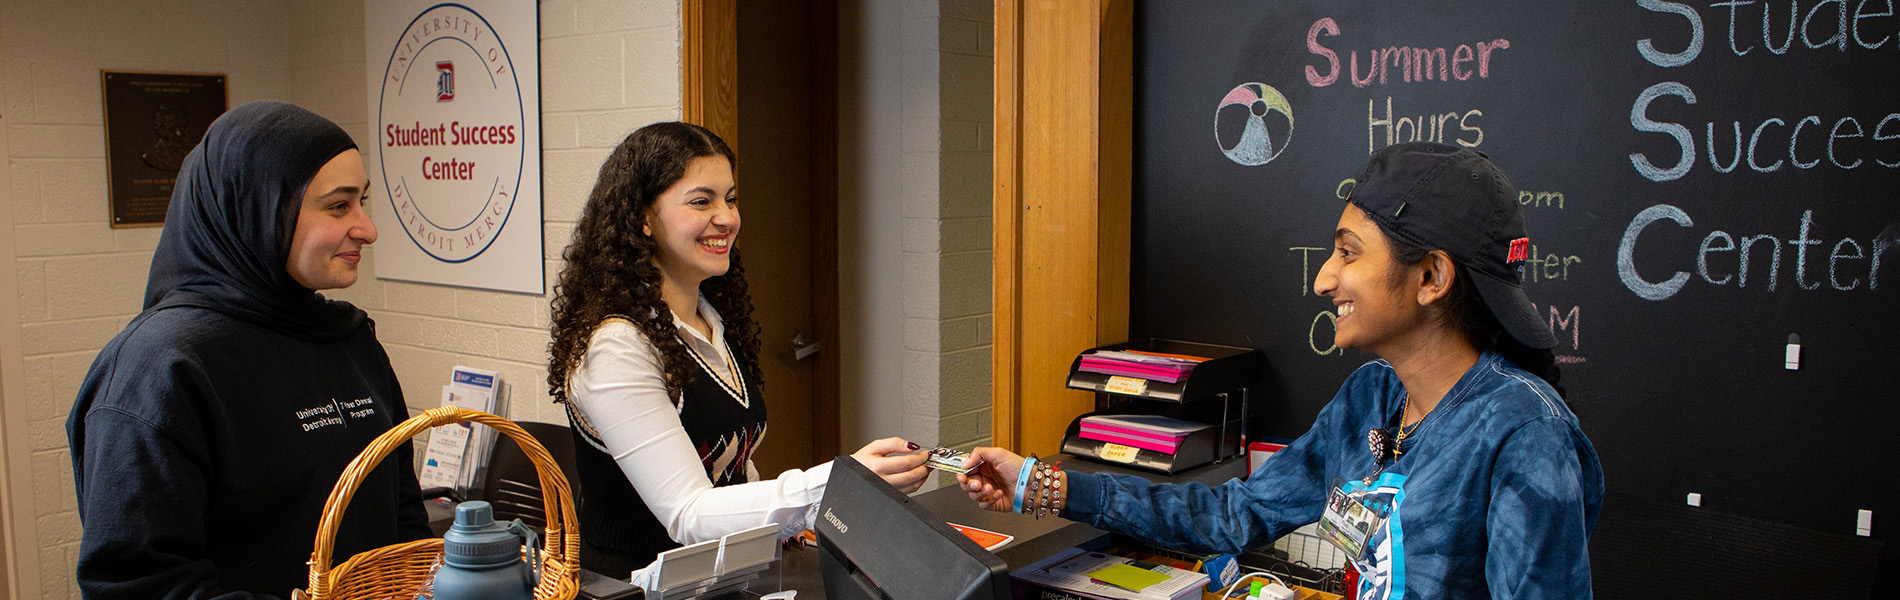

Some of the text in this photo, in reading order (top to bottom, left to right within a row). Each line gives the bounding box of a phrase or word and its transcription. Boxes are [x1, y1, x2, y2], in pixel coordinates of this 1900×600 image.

[392, 16, 506, 83] UNIVERSITY OF
[1305, 17, 1510, 88] Summer
[387, 121, 516, 147] Student Success
[1369, 96, 1484, 155] Hours
[1629, 81, 1900, 182] Succes
[422, 156, 475, 181] Center
[394, 184, 509, 252] DETROIT MERCY
[1617, 204, 1900, 301] Center
[302, 417, 328, 432] Detroit
[823, 507, 849, 534] lenovo
